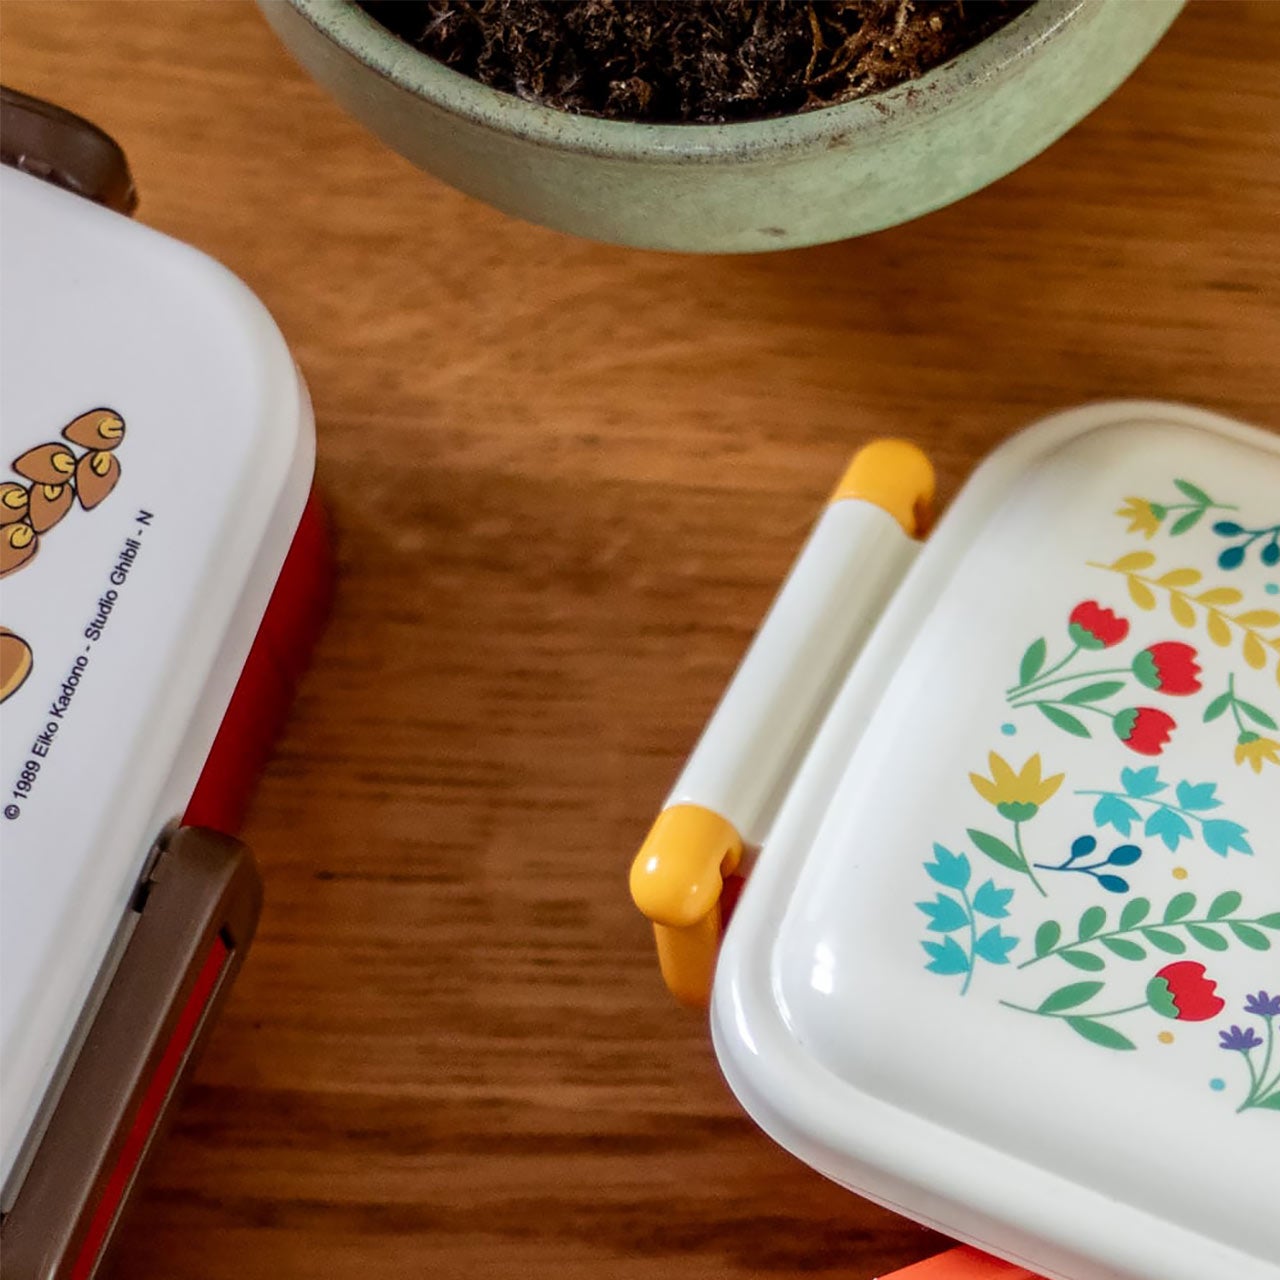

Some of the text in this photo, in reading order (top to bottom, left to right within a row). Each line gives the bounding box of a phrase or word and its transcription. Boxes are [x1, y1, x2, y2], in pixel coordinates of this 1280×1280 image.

[12, 760, 41, 799] 1989
[31, 722, 59, 758] Eiko
[48, 655, 89, 719] Kadono
[84, 589, 118, 641] Studio
[109, 537, 141, 586] Ghibli
[135, 509, 154, 526] N
